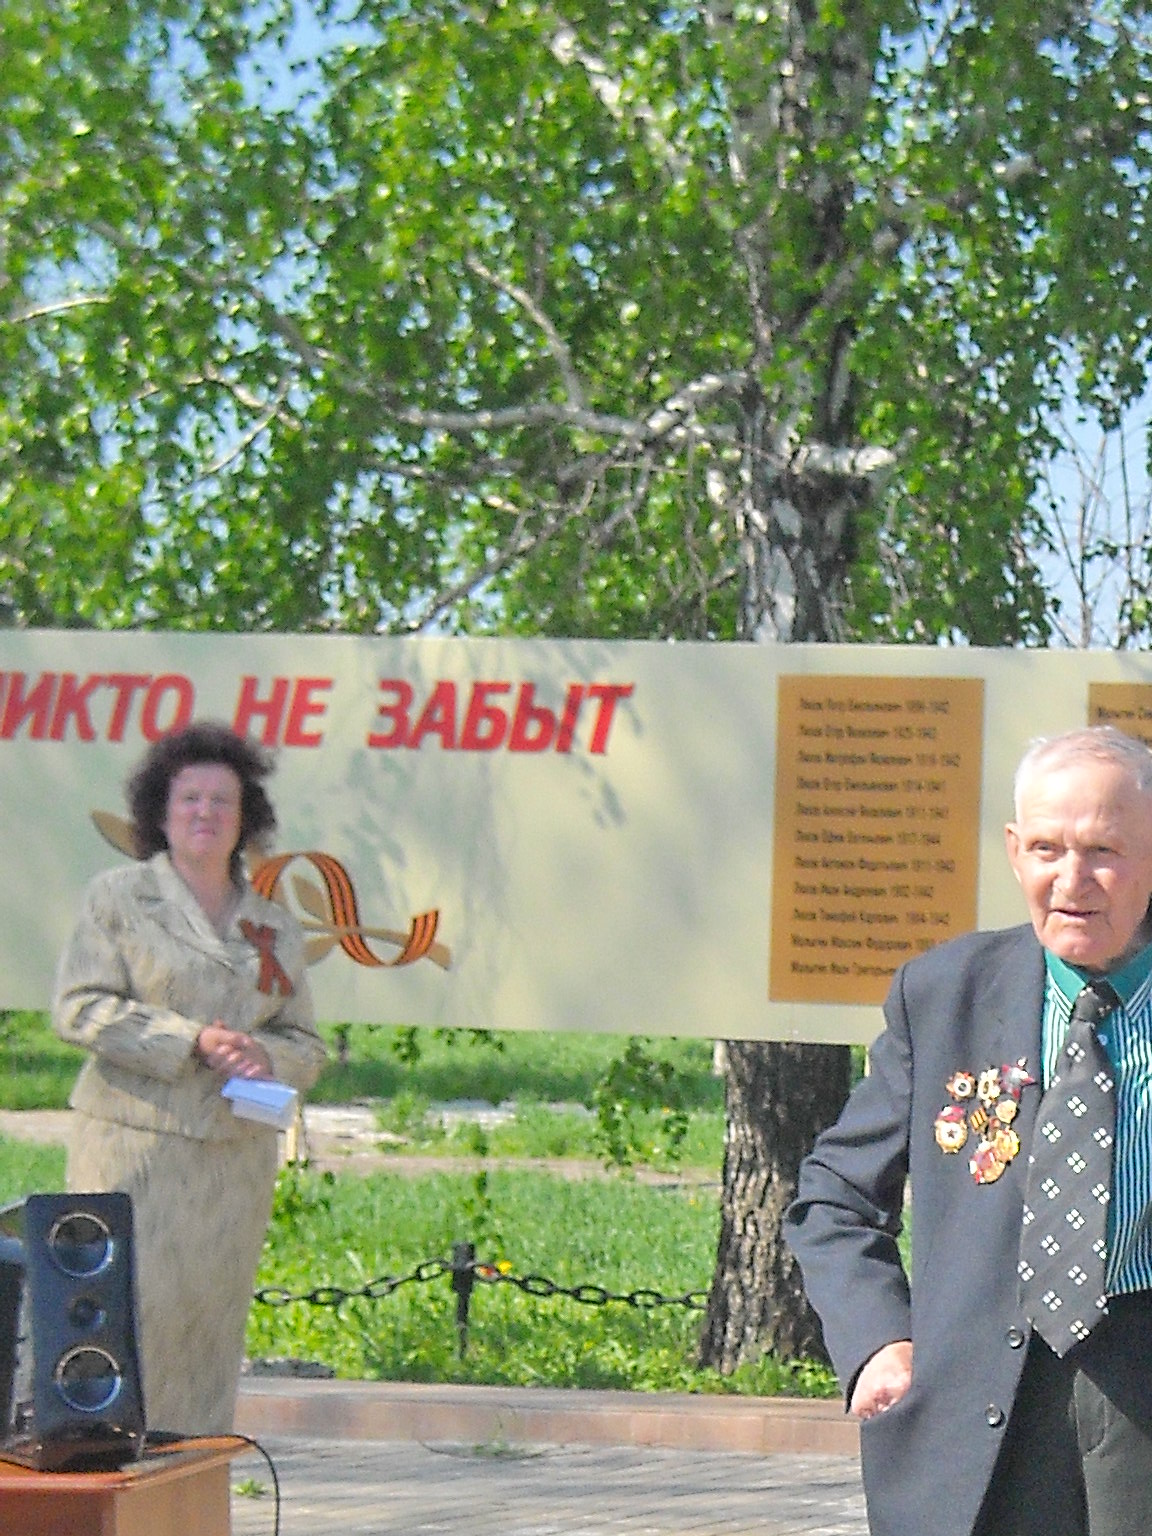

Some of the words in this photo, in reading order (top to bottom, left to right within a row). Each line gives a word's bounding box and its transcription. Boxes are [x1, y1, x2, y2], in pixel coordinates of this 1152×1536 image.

[0, 671, 194, 742] ИКТО
[232, 674, 333, 747] НЕ
[366, 678, 634, 755] ЗАБЫТ
